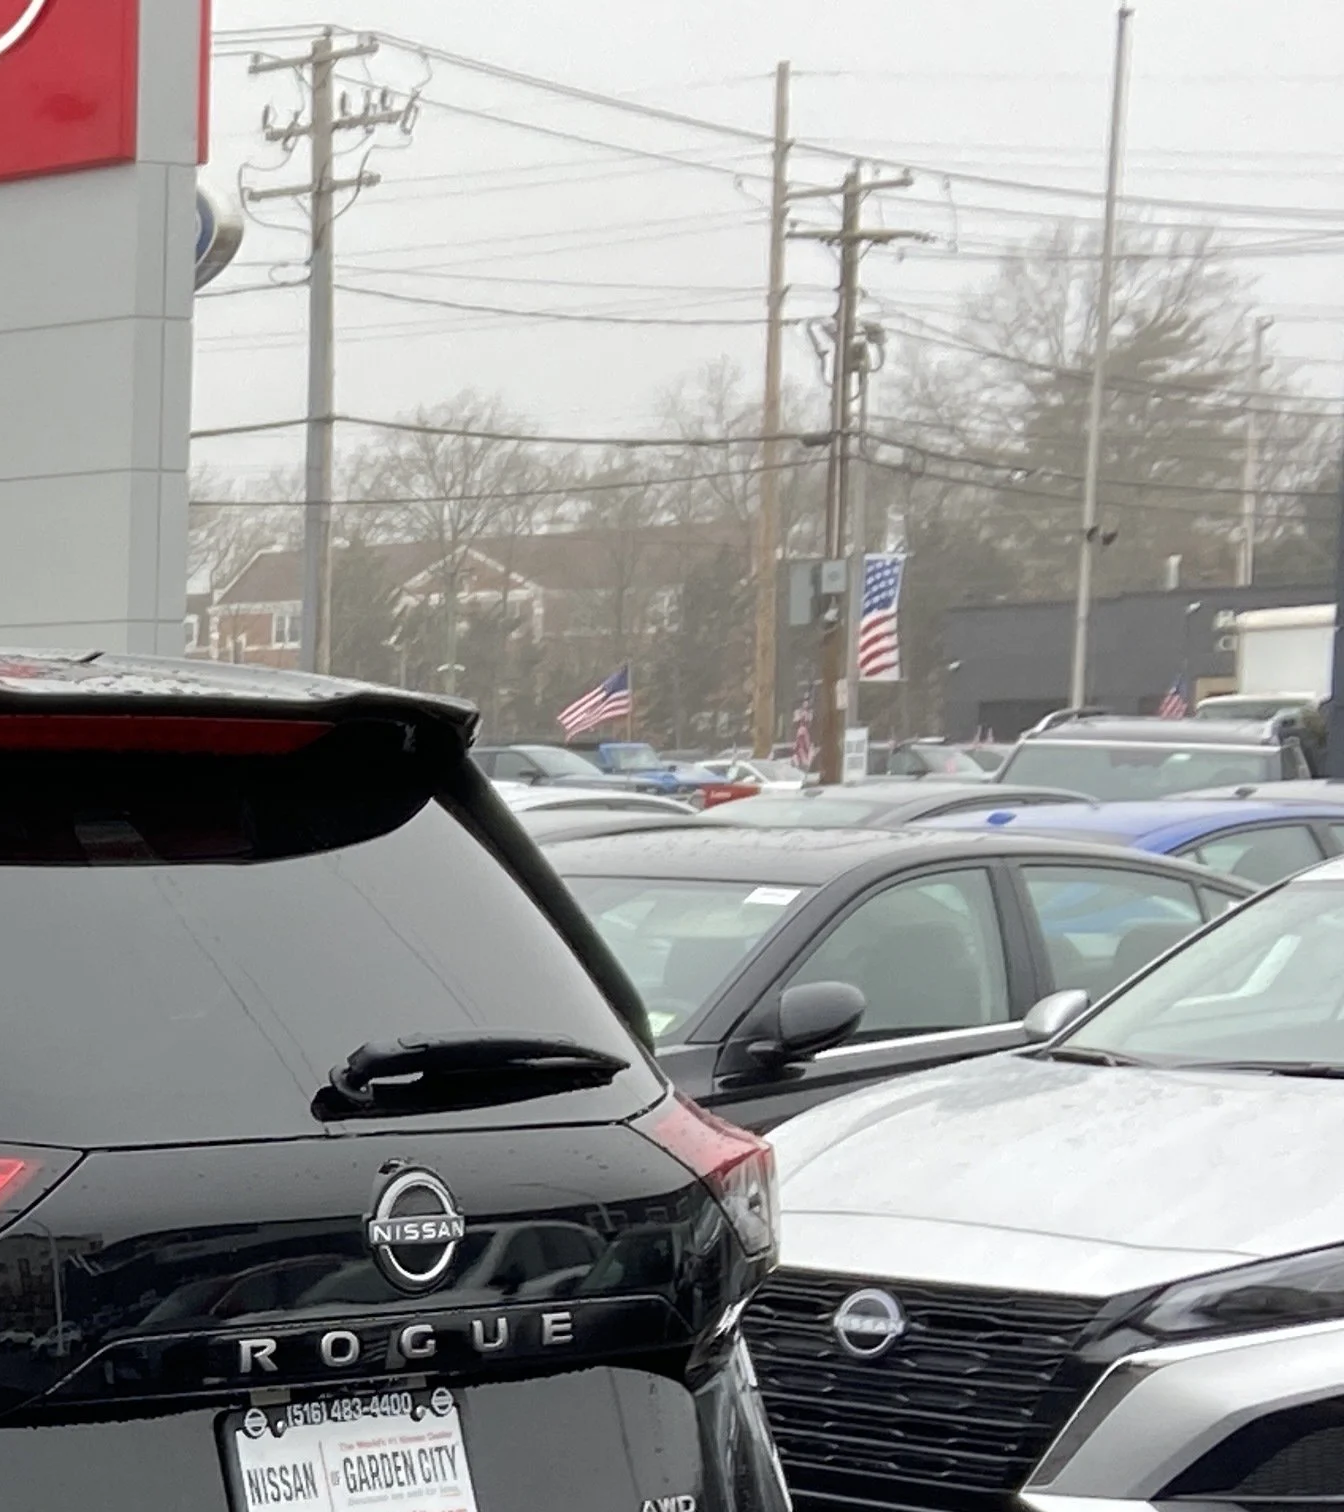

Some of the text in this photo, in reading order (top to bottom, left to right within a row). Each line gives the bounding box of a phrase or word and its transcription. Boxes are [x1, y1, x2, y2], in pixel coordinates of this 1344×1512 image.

[372, 1221, 465, 1243] NISSAN
[238, 1311, 574, 1374] ROGUE
[286, 1392, 413, 1427] (516) 483-4400
[246, 1461, 319, 1506] NISSAN
[343, 1449, 418, 1494] GARDEN
[417, 1445, 458, 1485] CITY
